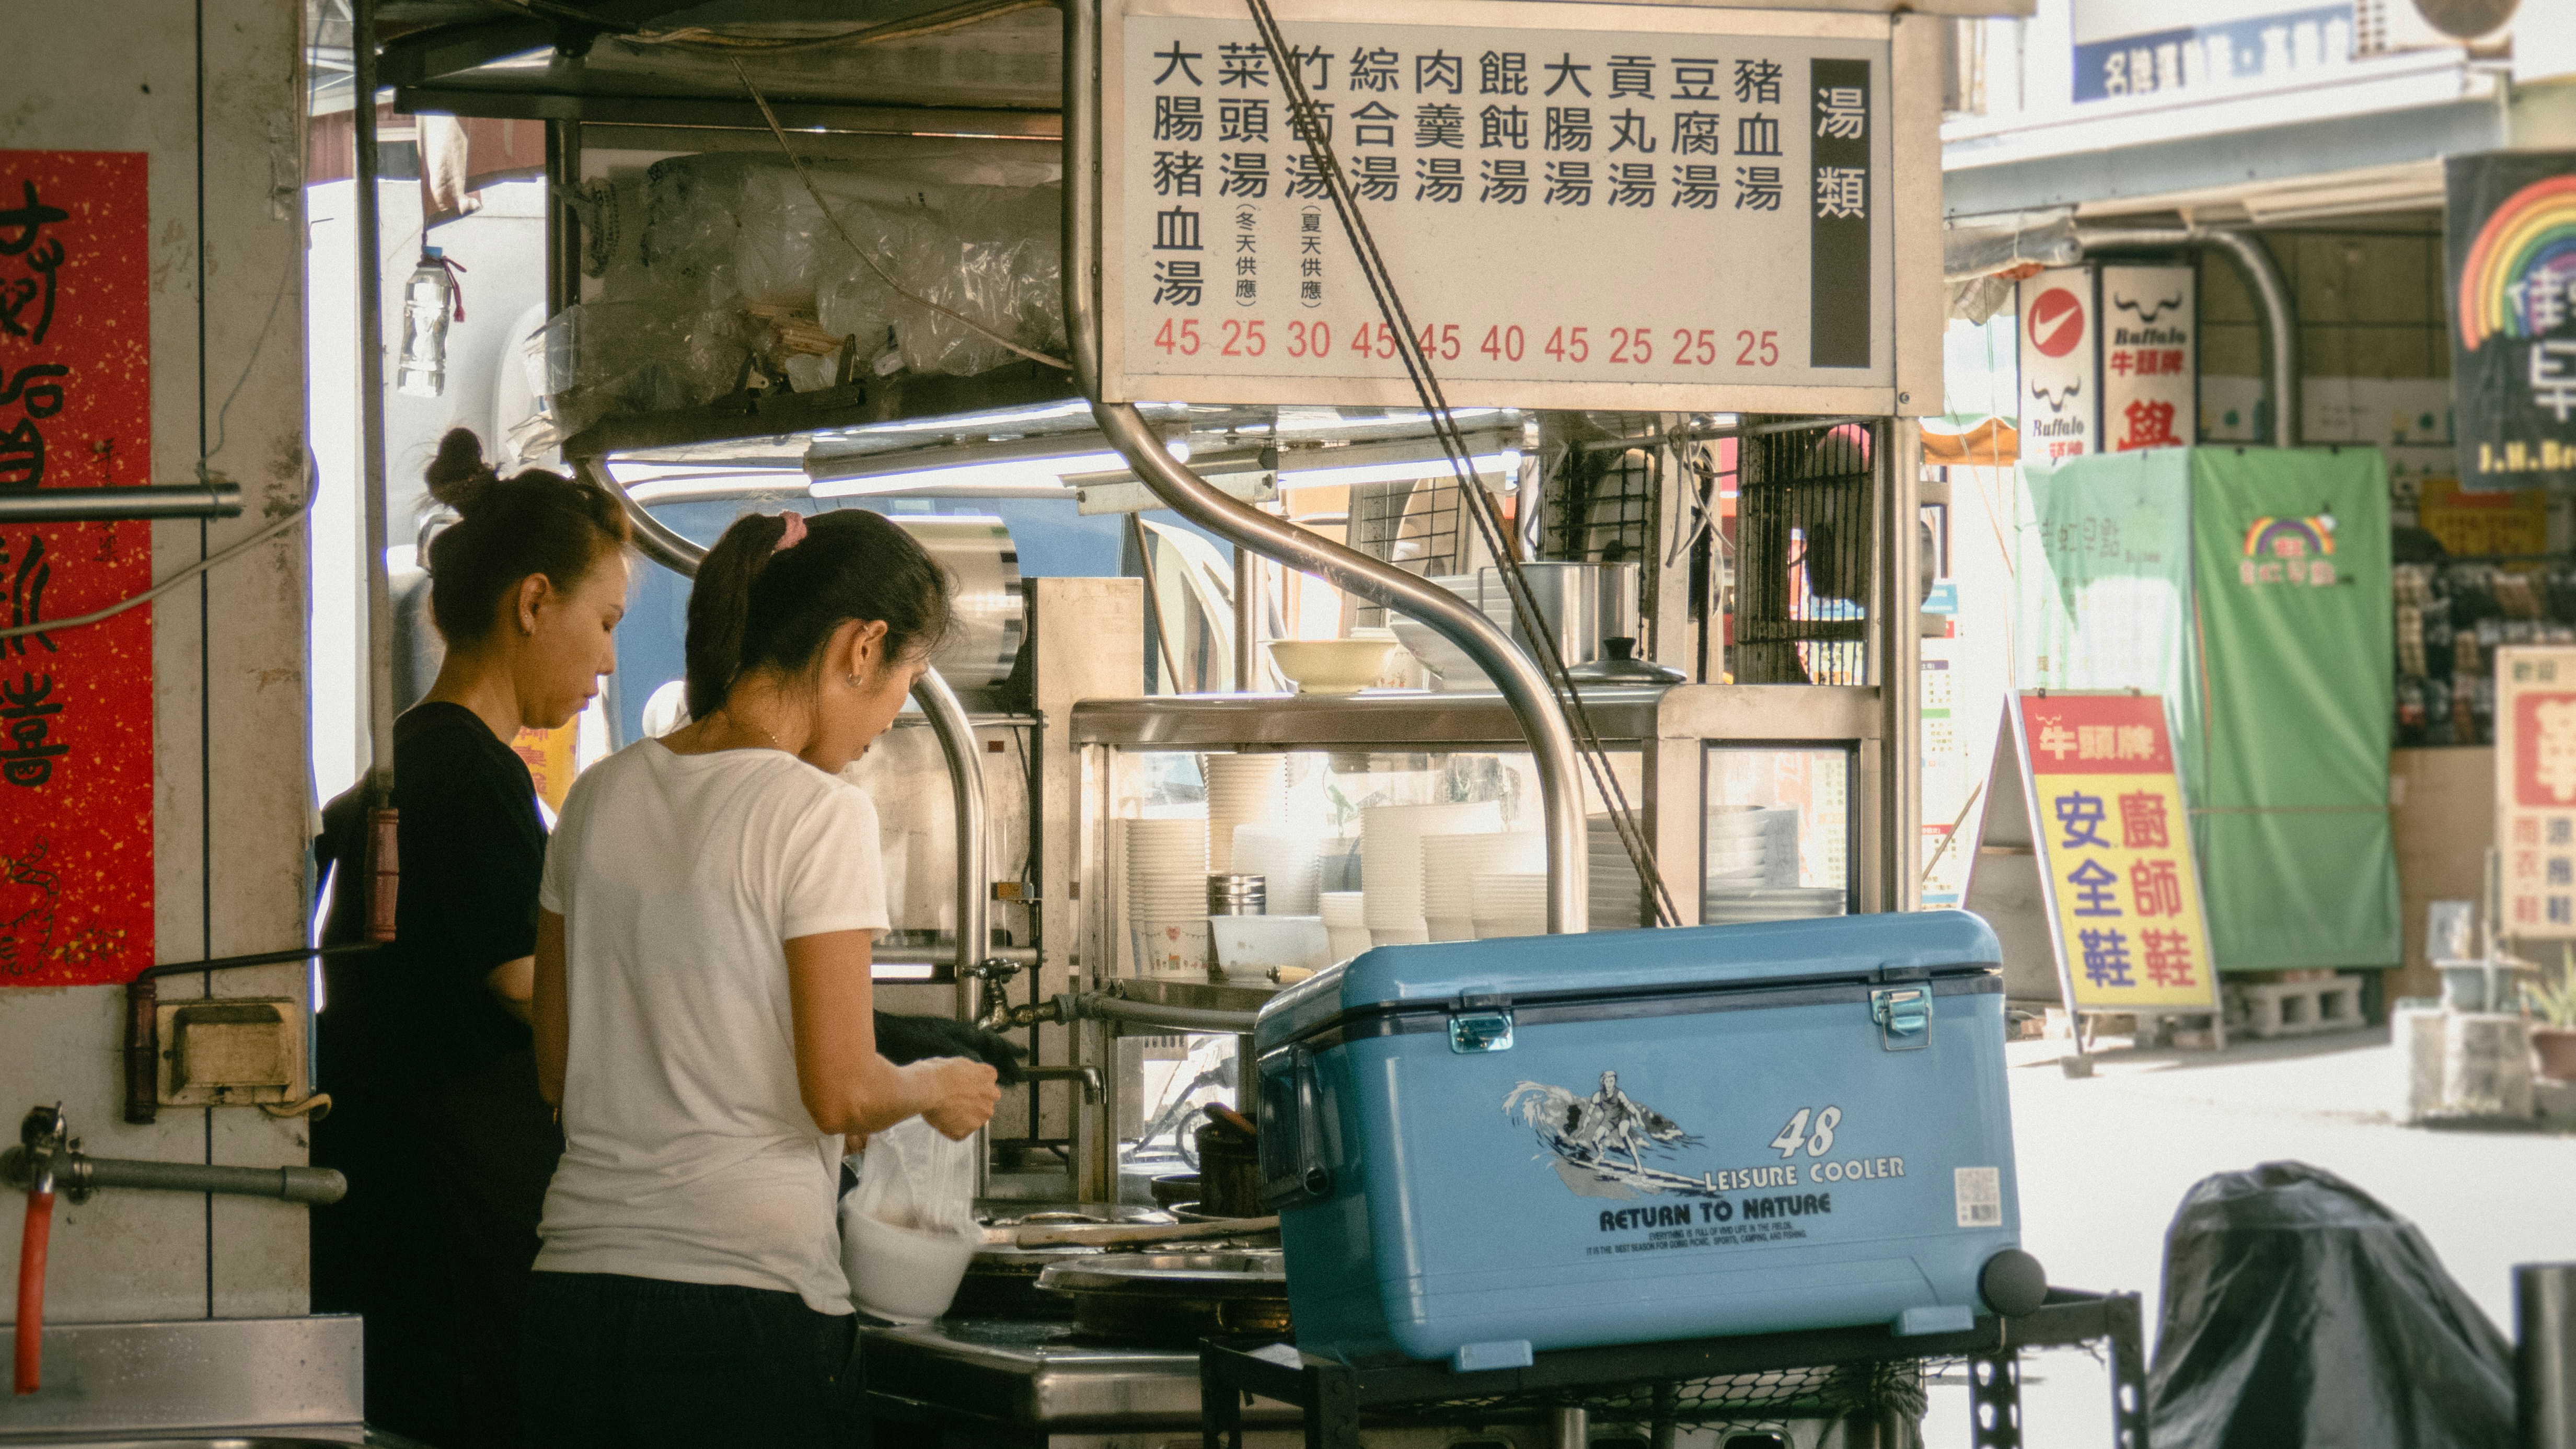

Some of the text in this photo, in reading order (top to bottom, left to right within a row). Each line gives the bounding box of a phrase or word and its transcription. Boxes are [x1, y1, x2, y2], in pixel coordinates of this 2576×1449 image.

[1152, 40, 1204, 307] 大腸豬血湯
[1218, 42, 1270, 199] 菜頭湯
[1349, 47, 1400, 202] 綜合湯
[1414, 49, 1465, 203] 肉羹湯
[1479, 50, 1529, 205] 餛飩湯
[1543, 52, 1593, 207] 大腸湯
[1607, 55, 1657, 208] 貢丸湯
[1670, 57, 1720, 210] 豆腐湯
[1734, 58, 1783, 211] 豬血湯
[1816, 87, 1866, 219] 湯類
[1154, 318, 1779, 367] 45 25 30 45 45 40 45 25 25 25
[2039, 724, 2155, 760] 牛頭牌
[2055, 790, 2136, 989] 安全鞋
[2118, 789, 2197, 989] 廚師鞋
[1704, 1156, 1905, 1192] LEISURE COOLER
[1771, 1105, 1842, 1158] 48
[1587, 1247, 1592, 1255] IT
[1615, 1244, 1629, 1253] BEST
[1631, 1242, 1655, 1252] SEASON
[1656, 1241, 1668, 1249] FOR
[1670, 1239, 1688, 1249] GOING
[1770, 1232, 1781, 1240] AND
[1599, 1193, 1831, 1232] RETURN TO NATURE
[1649, 1230, 1684, 1241] EVERYTHING
[1686, 1229, 1692, 1237] IS
[1695, 1228, 1708, 1237] FULL
[1710, 1227, 1717, 1236] OF
[1735, 1225, 1747, 1233] LIFE
